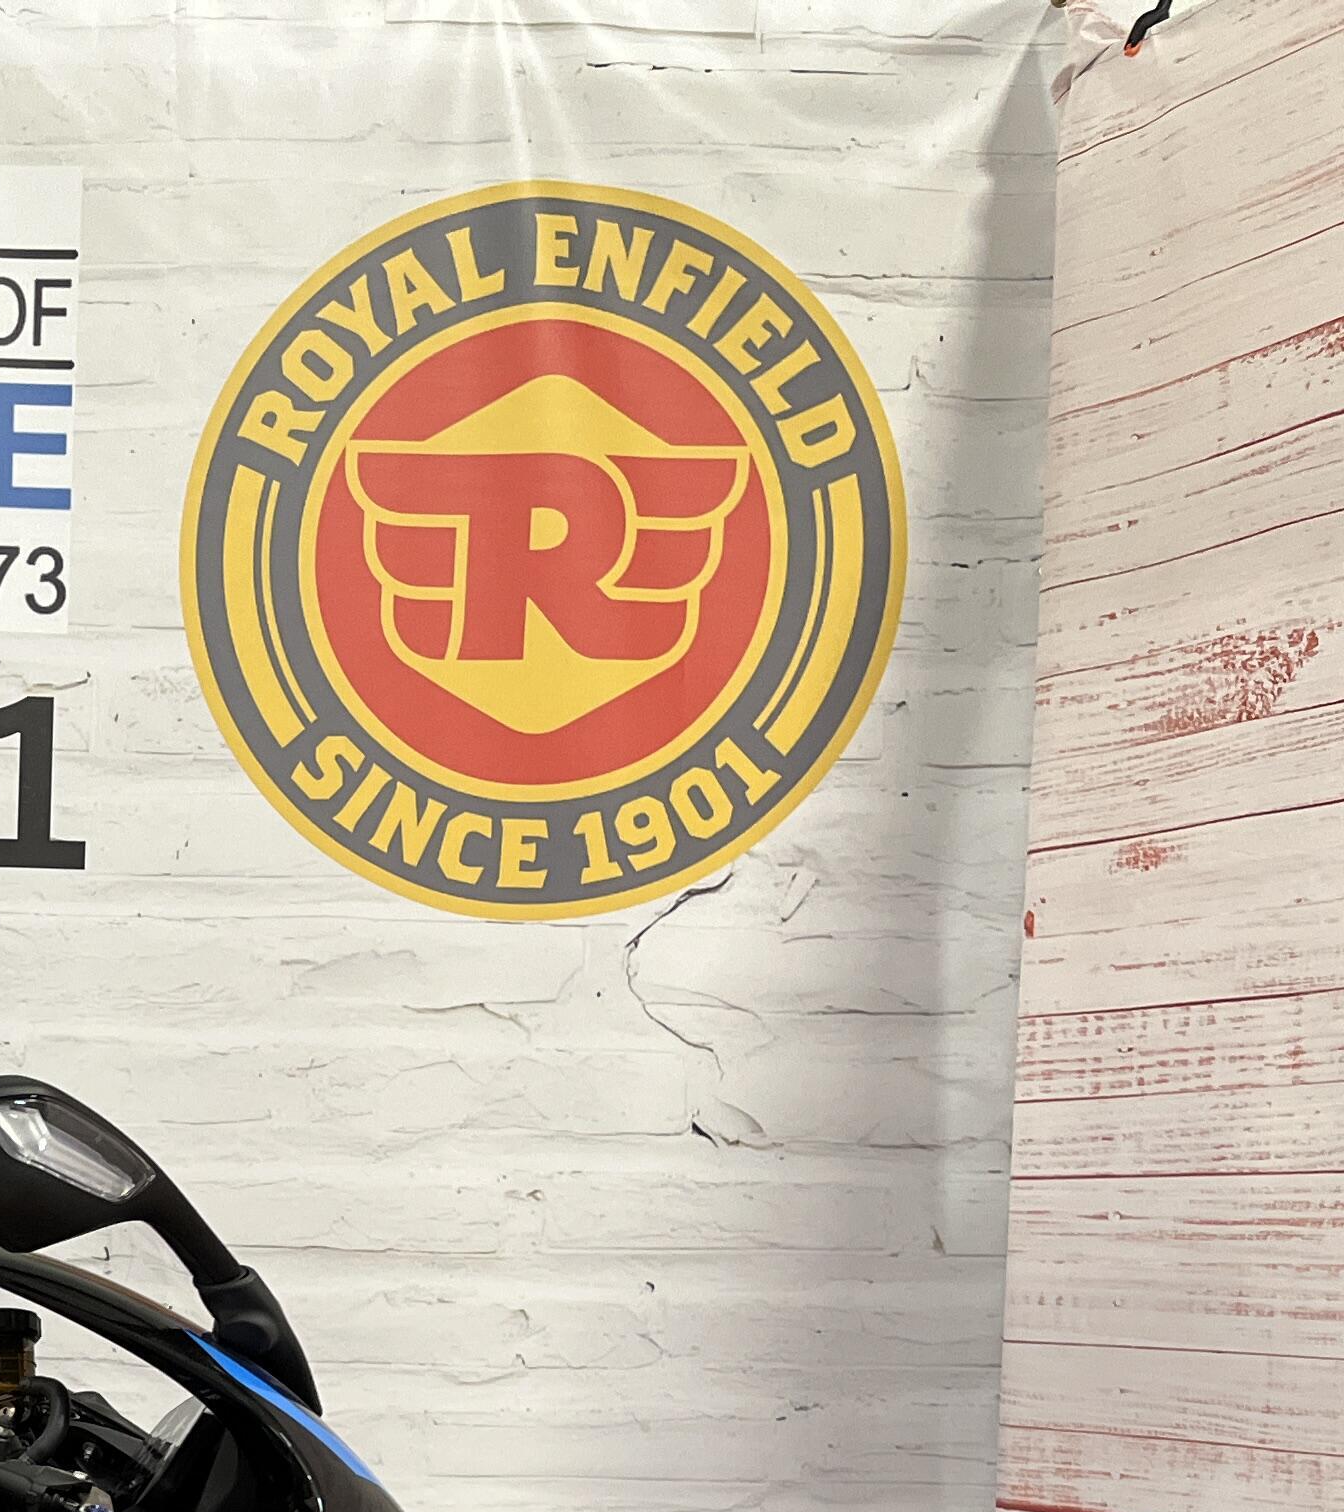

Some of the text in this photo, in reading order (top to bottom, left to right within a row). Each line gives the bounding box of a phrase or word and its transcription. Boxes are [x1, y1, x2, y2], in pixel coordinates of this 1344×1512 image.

[236, 213, 856, 469] ROYAL ENFIELD
[291, 734, 782, 889] SINCE 1901
